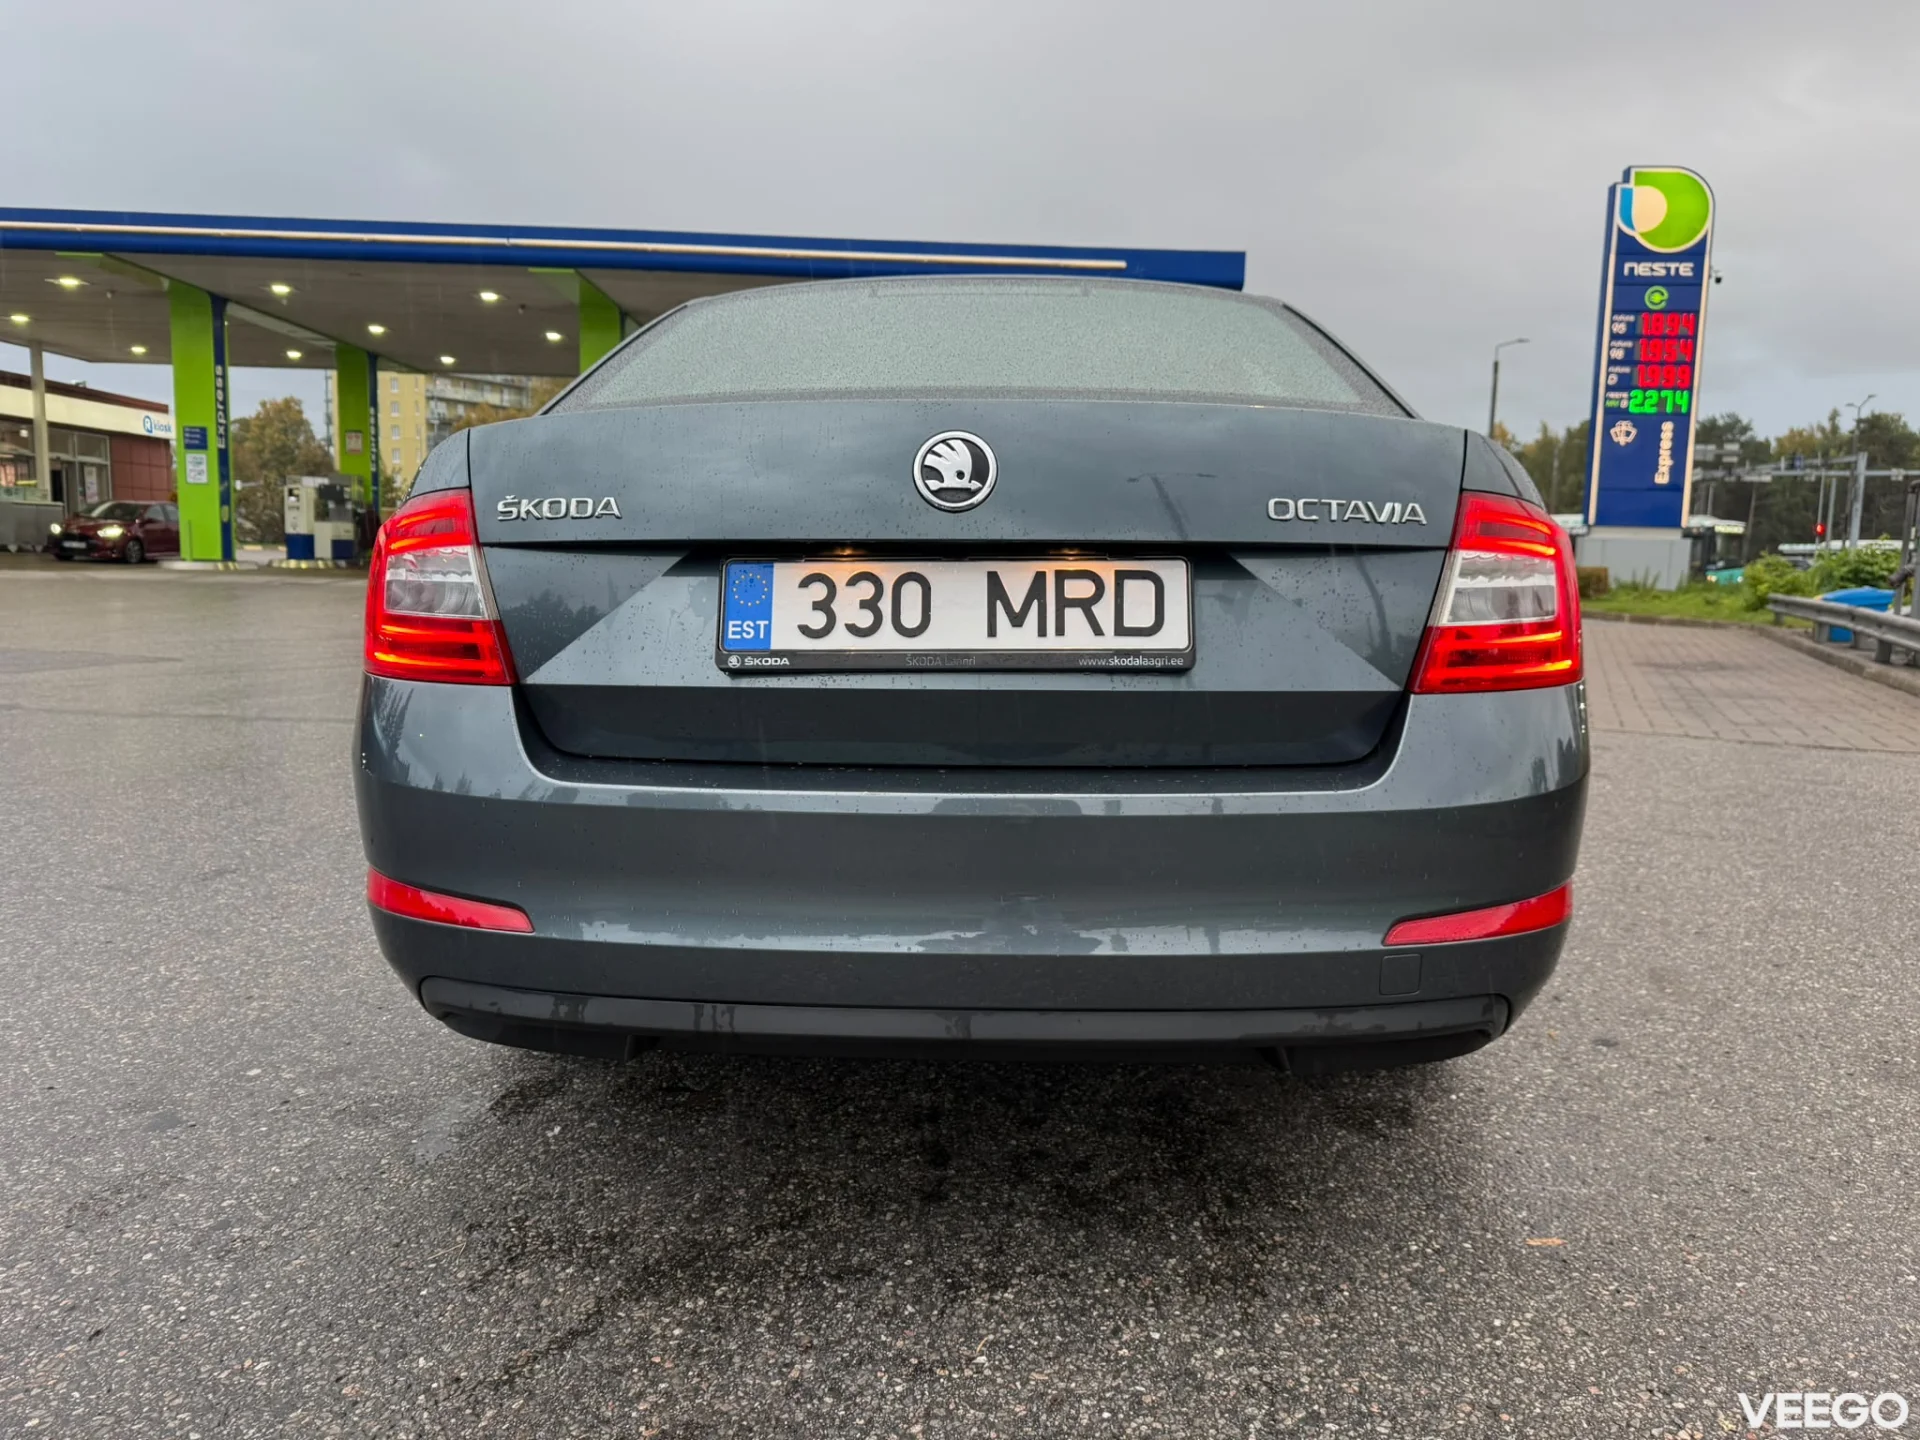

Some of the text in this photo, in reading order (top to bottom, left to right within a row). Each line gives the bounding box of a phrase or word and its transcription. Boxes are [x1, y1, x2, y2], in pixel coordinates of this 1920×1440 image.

[1624, 262, 1694, 276] NESTE
[215, 366, 226, 449] Express
[1654, 421, 1674, 484] Express
[497, 495, 622, 520] ŠKODA
[1267, 498, 1428, 525] OCTAVIA
[797, 569, 1165, 639] 330 MRD
[728, 620, 769, 639] EST
[744, 655, 790, 666] ŠKODA
[1079, 655, 1184, 667] www.skodalaagri.ee
